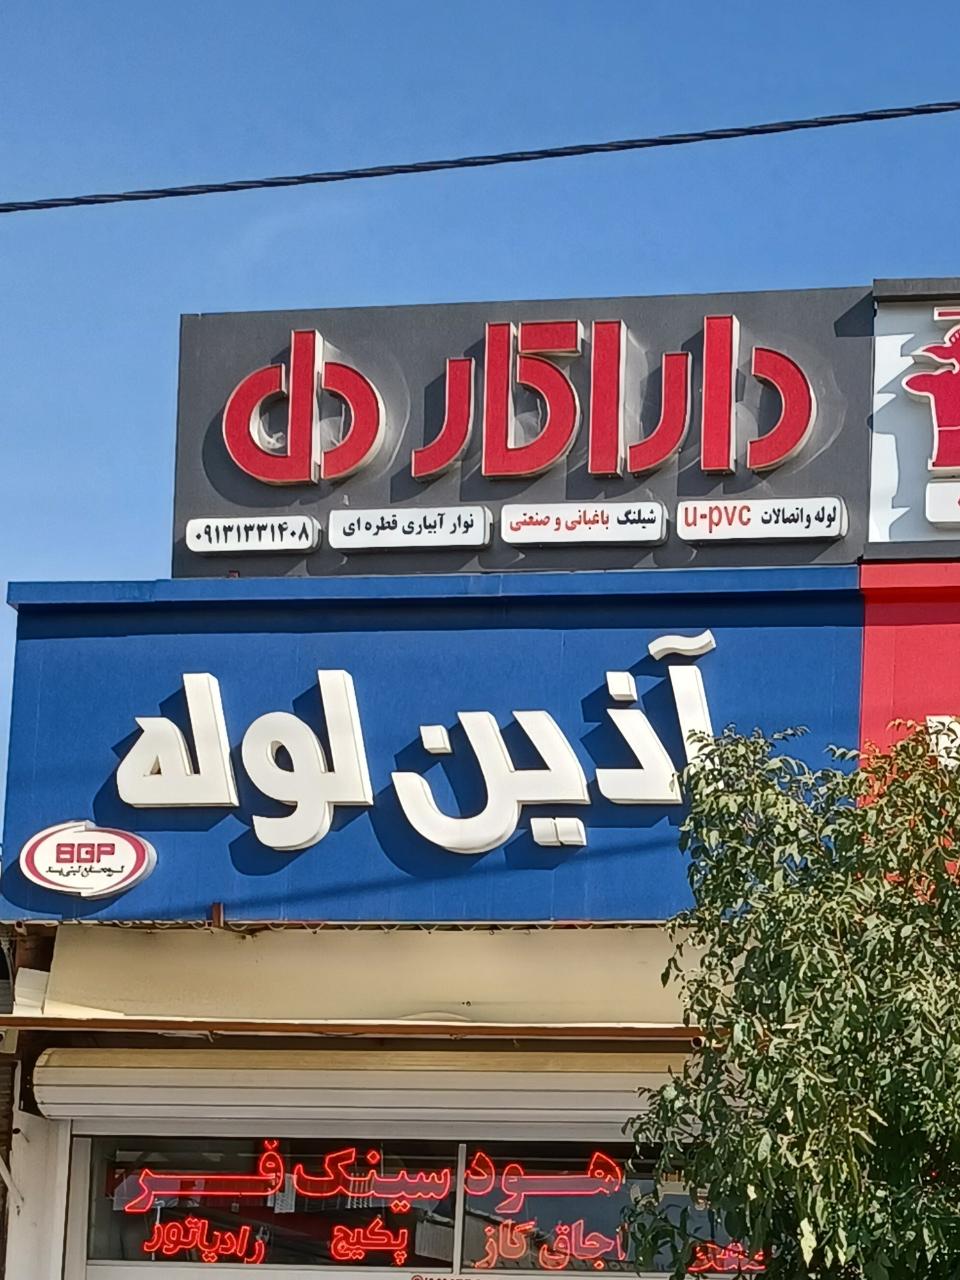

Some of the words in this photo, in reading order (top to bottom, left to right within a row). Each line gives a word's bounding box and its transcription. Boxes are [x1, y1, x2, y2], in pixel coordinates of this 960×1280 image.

[196, 522, 309, 543] ۰۹۱۳۱۳۳۱۴۰۸
[402, 513, 445, 534] آبیاری
[450, 514, 474, 534] نوار
[510, 512, 550, 531] صنعتی
[554, 516, 561, 531] و
[565, 509, 609, 531] باغبانی
[814, 505, 836, 528] لوله
[116, 669, 373, 850] لوله
[391, 629, 718, 855] آذین
[124, 1140, 283, 1212] فر
[294, 1148, 450, 1213] سینک
[464, 1152, 621, 1213] هود
[143, 1218, 265, 1264] رادیاتور
[331, 1217, 408, 1265] پکیج
[475, 1219, 535, 1269] گاز
[539, 1219, 626, 1269] اجاق
